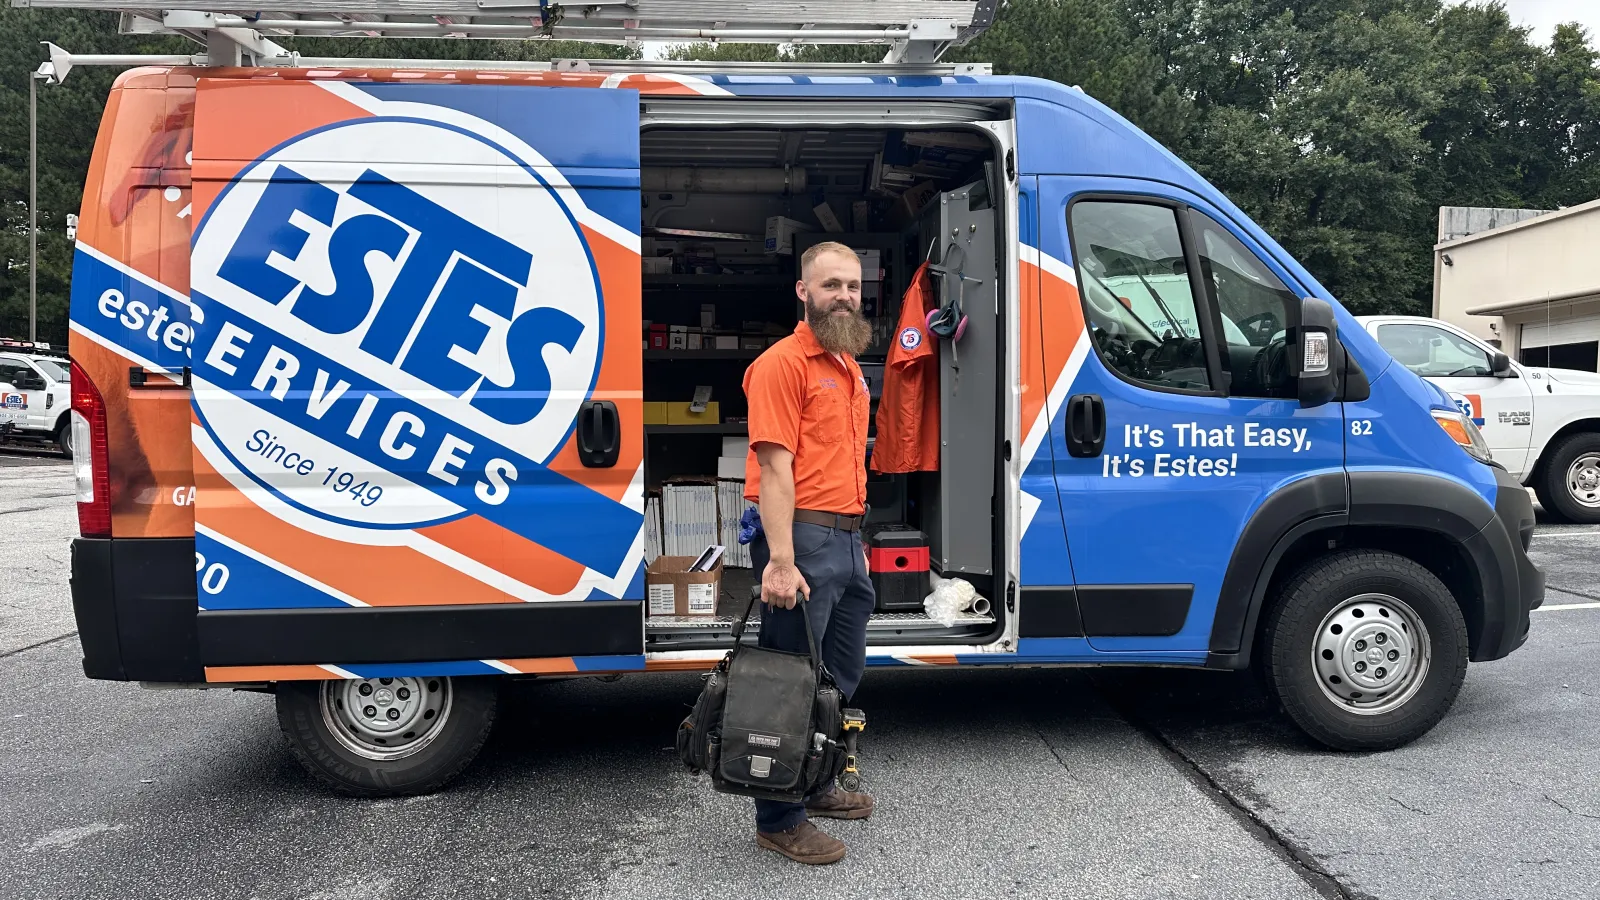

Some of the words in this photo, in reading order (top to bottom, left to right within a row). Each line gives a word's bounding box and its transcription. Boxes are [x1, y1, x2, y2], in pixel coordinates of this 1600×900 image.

[216, 163, 586, 426] ESTES
[98, 288, 191, 359] este
[1124, 424, 1164, 448] It's
[1172, 422, 1235, 448] That
[1244, 422, 1312, 453] Easy,
[1351, 420, 1373, 436] 82
[246, 429, 315, 476] Since
[325, 466, 383, 507] 1949
[1102, 454, 1145, 478] It's
[1153, 453, 1238, 477] Estes!
